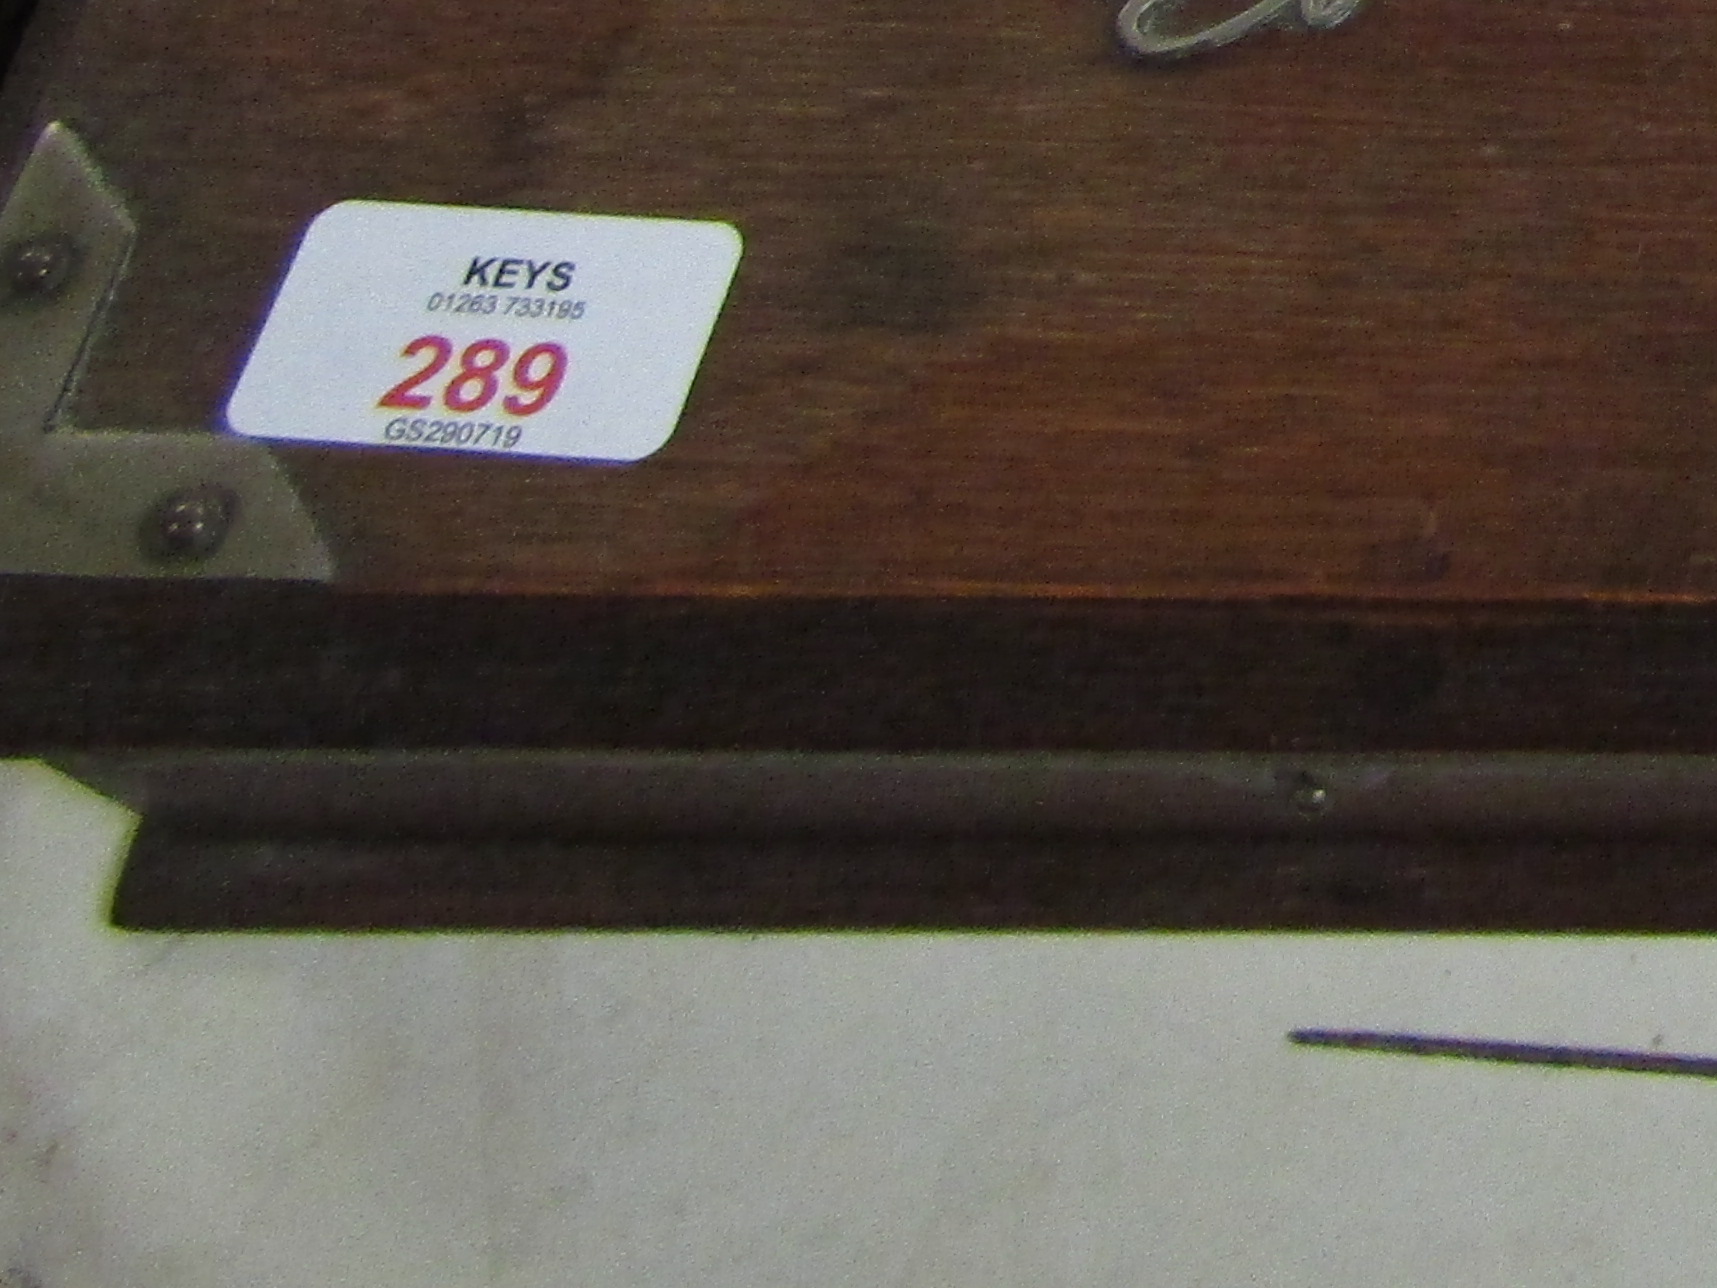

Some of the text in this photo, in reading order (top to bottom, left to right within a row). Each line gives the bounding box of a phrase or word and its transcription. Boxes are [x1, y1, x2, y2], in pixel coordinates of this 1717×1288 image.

[463, 257, 576, 291] KEYS
[427, 292, 586, 321] 01263 733195
[376, 334, 568, 417] 289
[385, 417, 523, 449] GS290719
